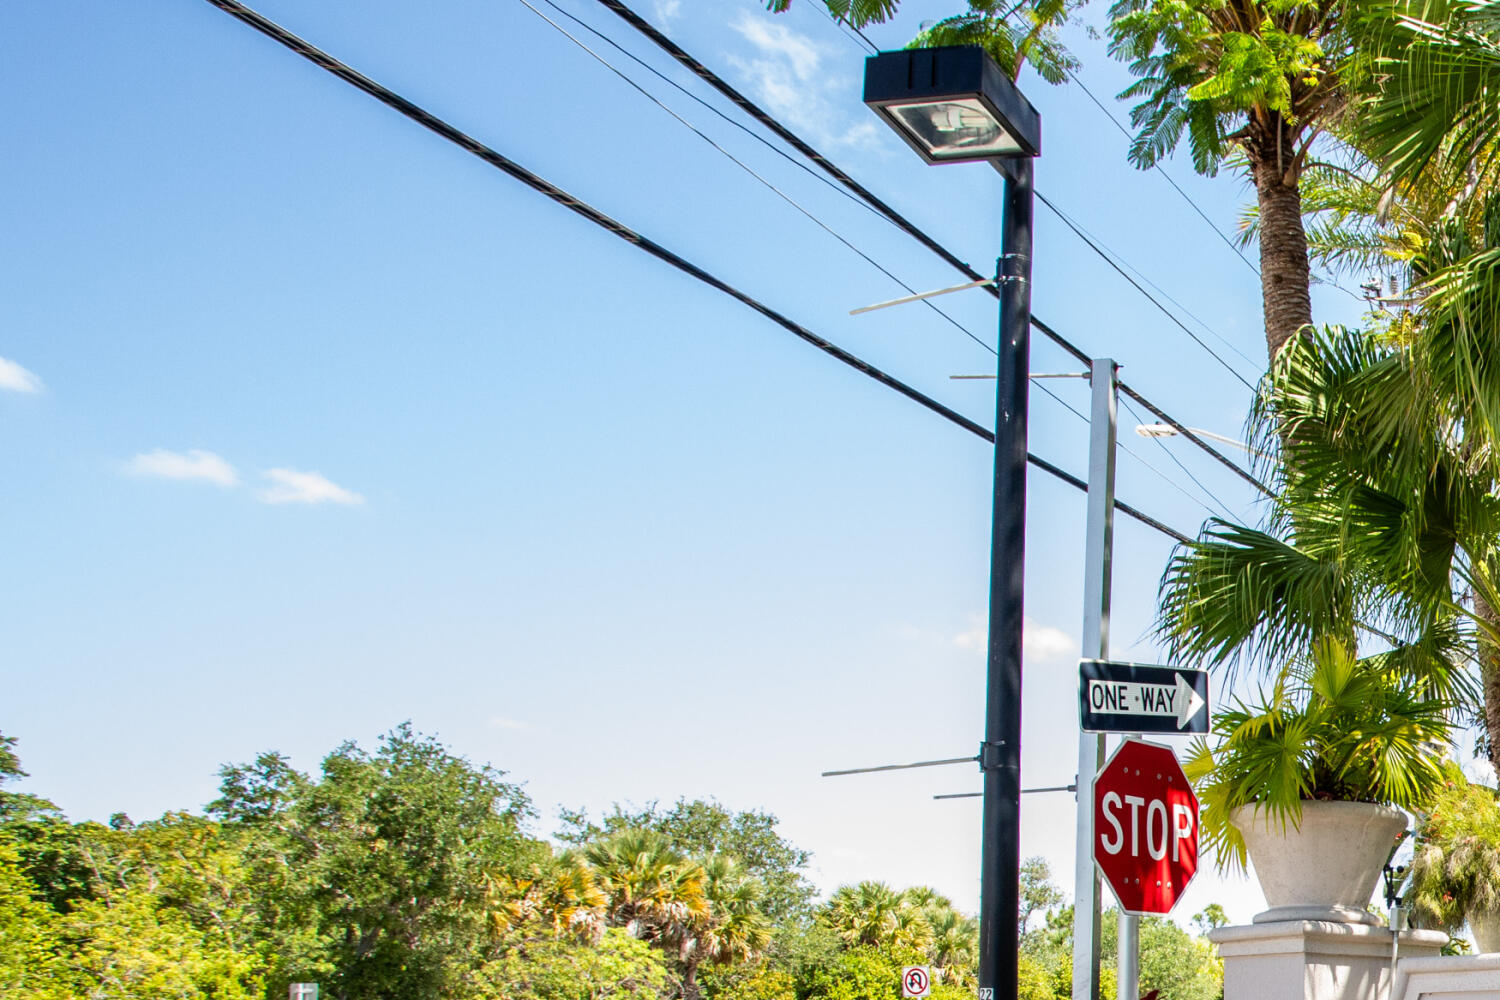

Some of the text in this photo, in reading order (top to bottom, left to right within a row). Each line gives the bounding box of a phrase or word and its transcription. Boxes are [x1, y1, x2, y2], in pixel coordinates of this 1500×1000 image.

[1092, 684, 1176, 713] ONE WAY
[1101, 791, 1193, 862] STOP
